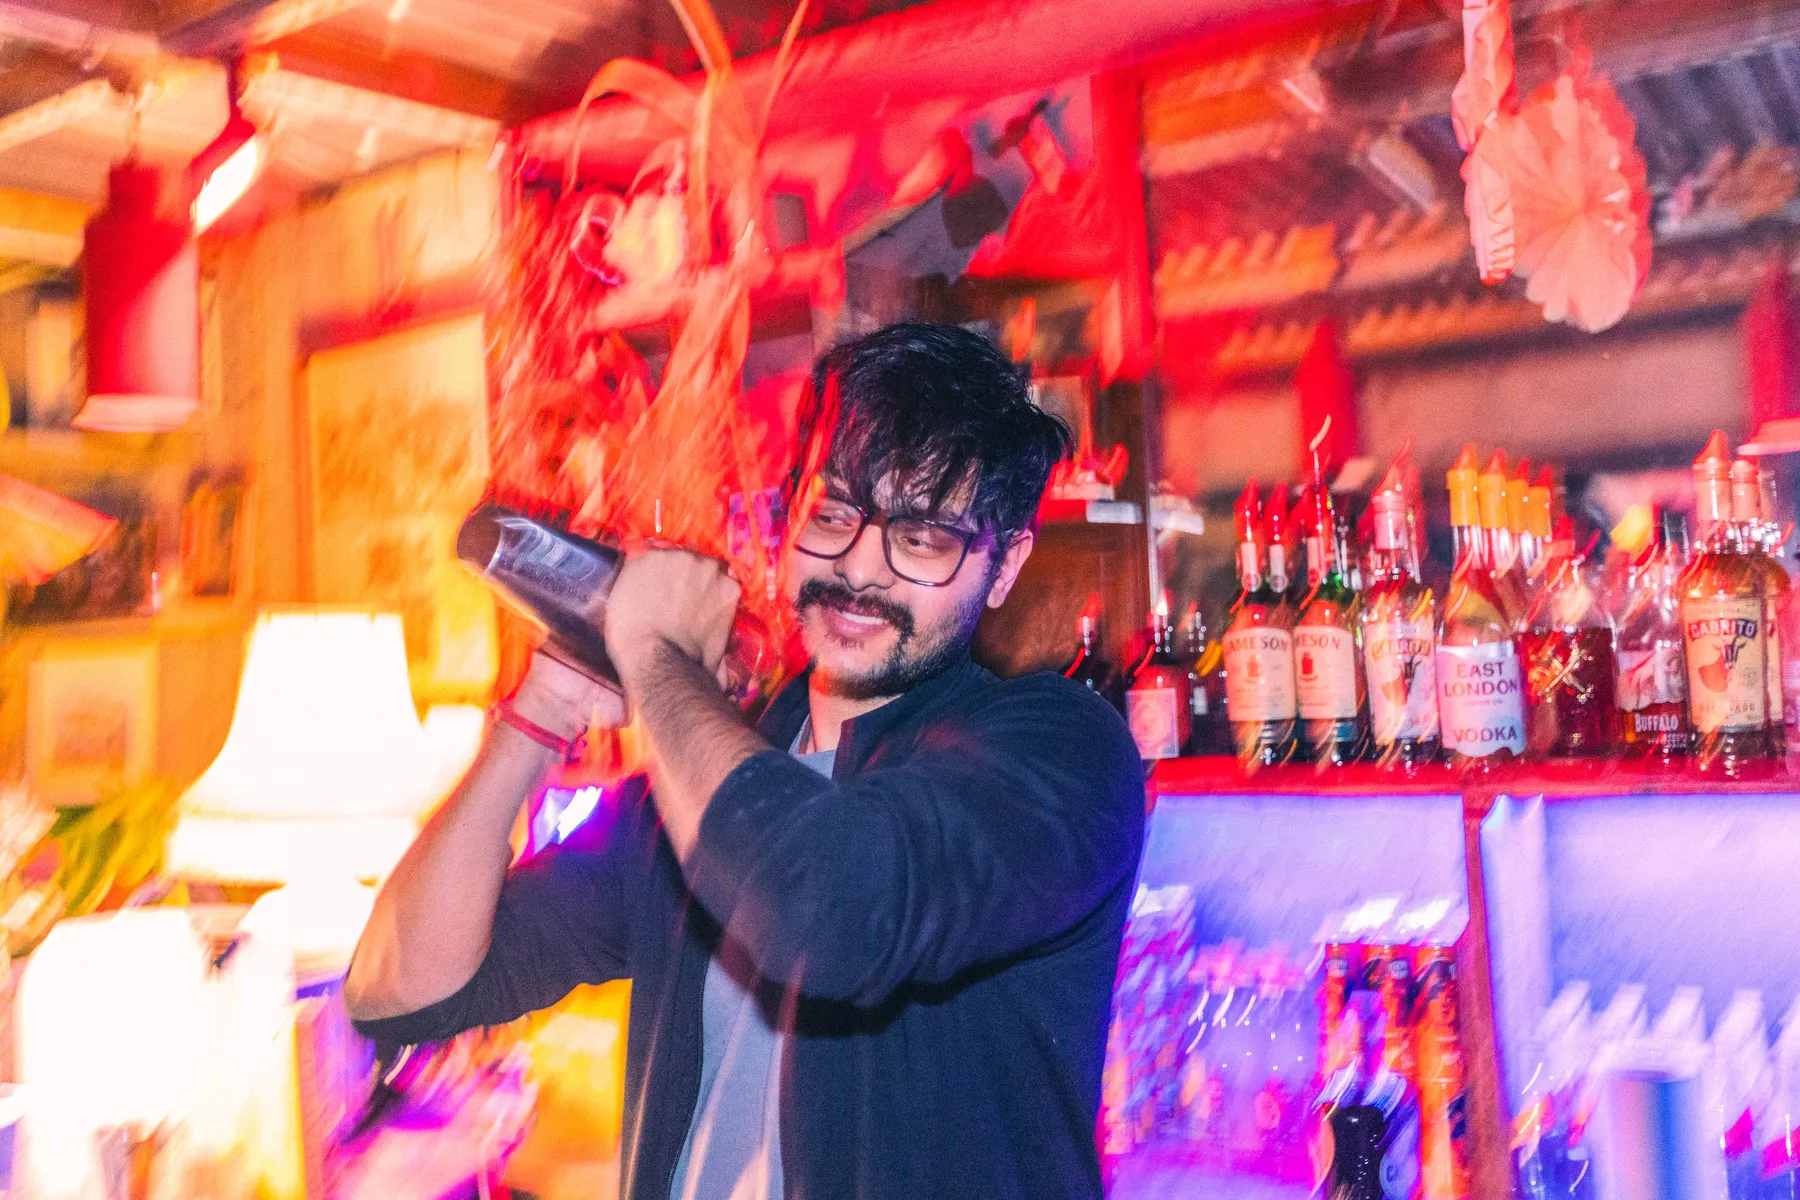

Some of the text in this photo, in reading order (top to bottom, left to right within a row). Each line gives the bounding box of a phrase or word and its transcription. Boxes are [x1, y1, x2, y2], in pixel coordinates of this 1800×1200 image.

[1690, 619, 1755, 639] CABRITO
[1456, 662, 1505, 677] EAST
[1444, 680, 1518, 698] LONDON
[1635, 713, 1679, 733] BUFFALO
[1453, 725, 1519, 743] VODKA
